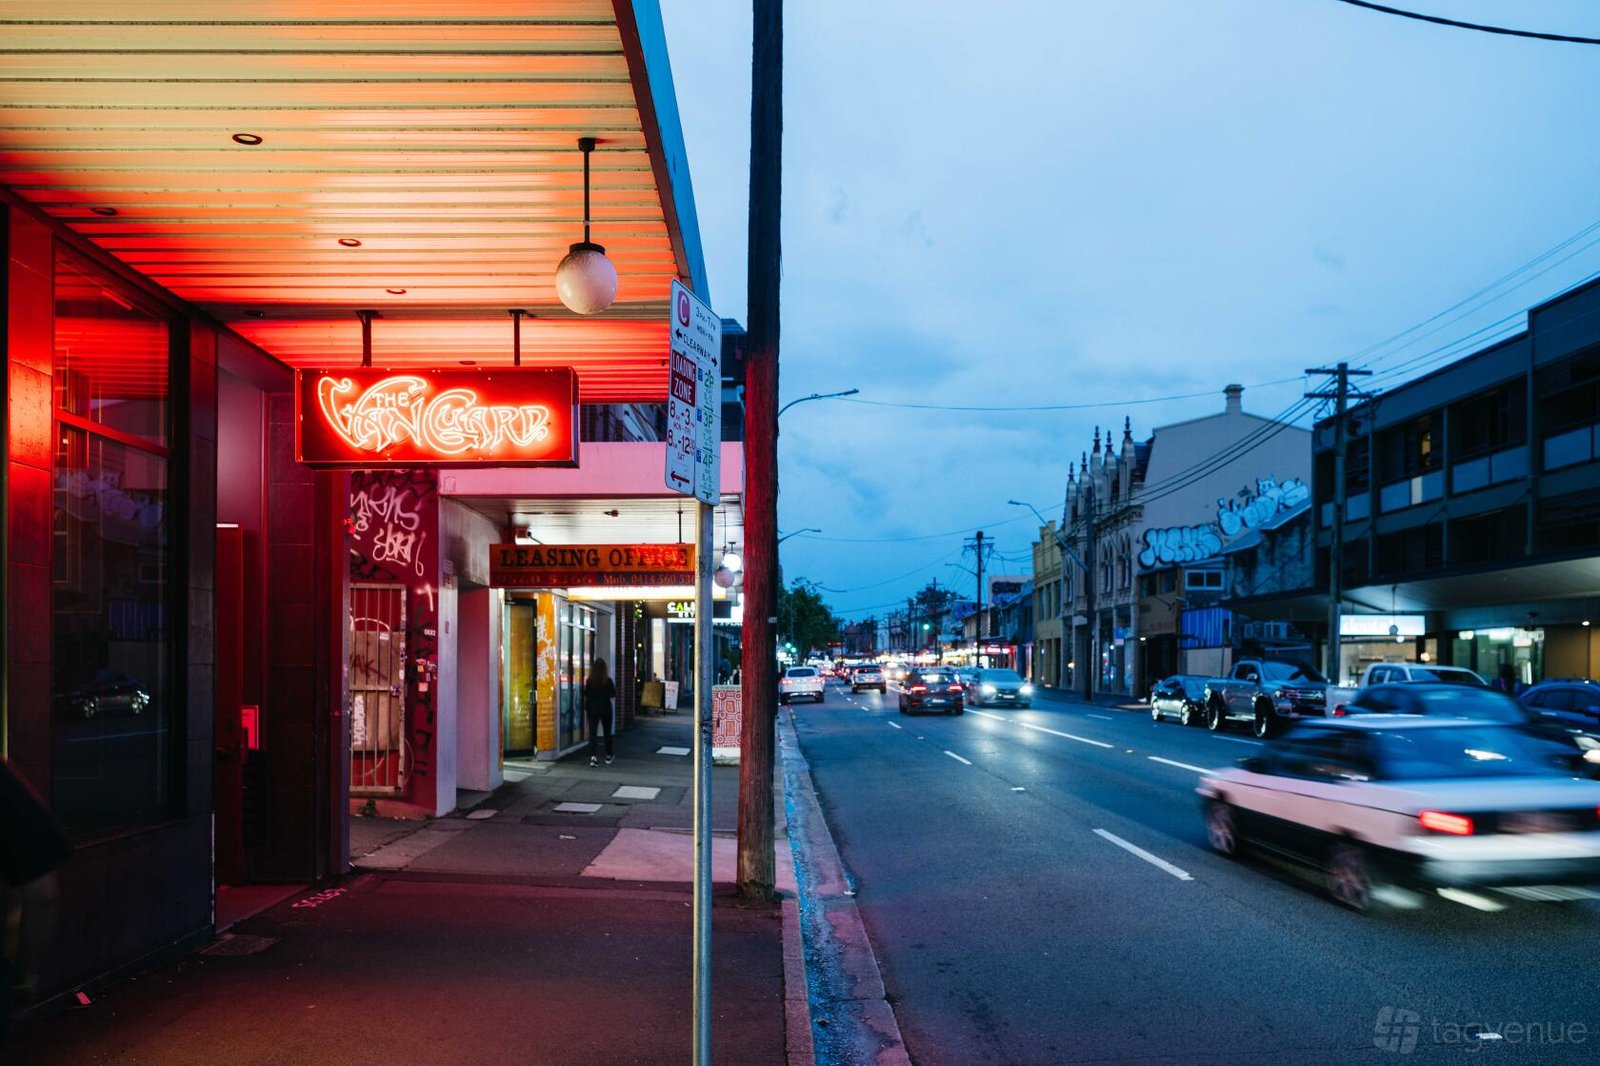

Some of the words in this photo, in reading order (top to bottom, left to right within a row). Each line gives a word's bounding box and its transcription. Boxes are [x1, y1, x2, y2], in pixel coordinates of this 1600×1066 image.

[683, 334, 711, 360] CLEARWAY
[672, 352, 695, 382] LOADING
[373, 391, 409, 408] THE
[673, 377, 692, 403] ZONE
[500, 548, 600, 568] LEASING
[608, 548, 688, 568] OFFICE
